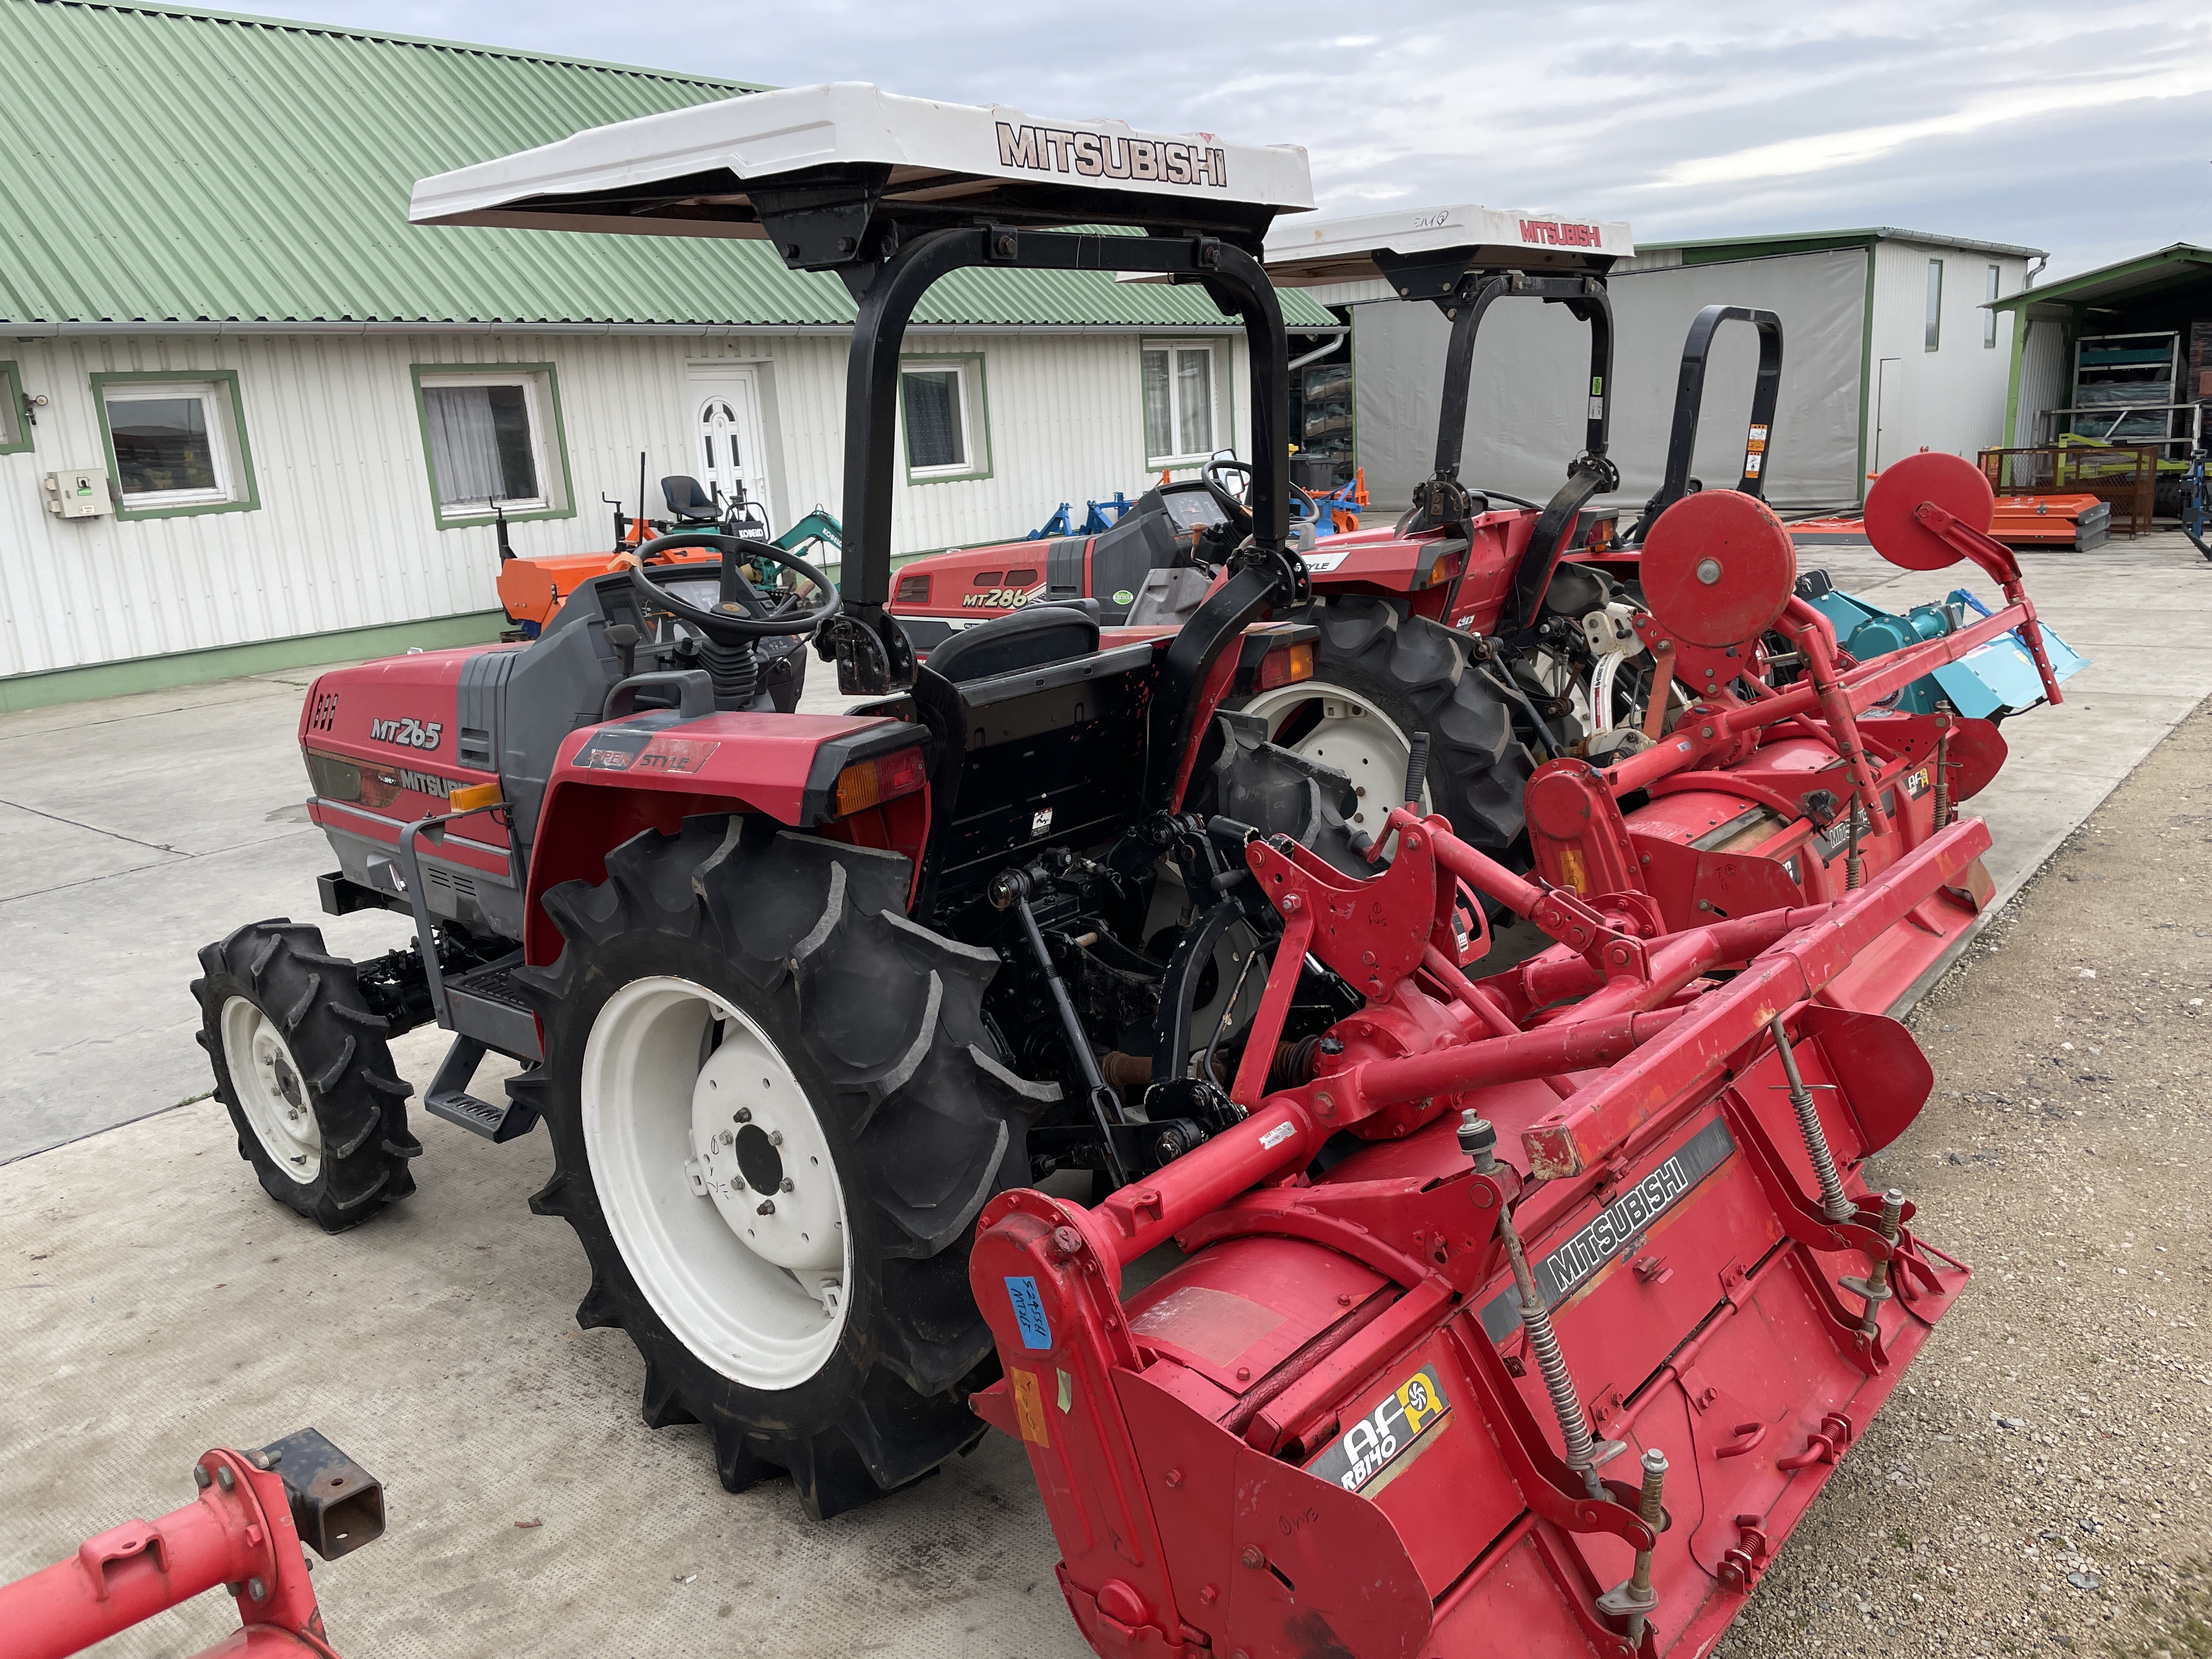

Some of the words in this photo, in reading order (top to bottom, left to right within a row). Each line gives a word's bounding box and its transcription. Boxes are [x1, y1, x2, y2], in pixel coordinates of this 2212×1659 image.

[995, 122, 1227, 188] MITSUBISHI
[1519, 219, 1602, 248] MITSUBISHI
[738, 528, 764, 539] KOBELCO
[962, 588, 1029, 609] MT286
[370, 716, 443, 752] MT265
[588, 749, 634, 767] OPEN
[640, 754, 690, 769] STYLE
[1547, 1156, 1689, 1293] MITSUBISHI
[1341, 1435, 1397, 1491] RB140
